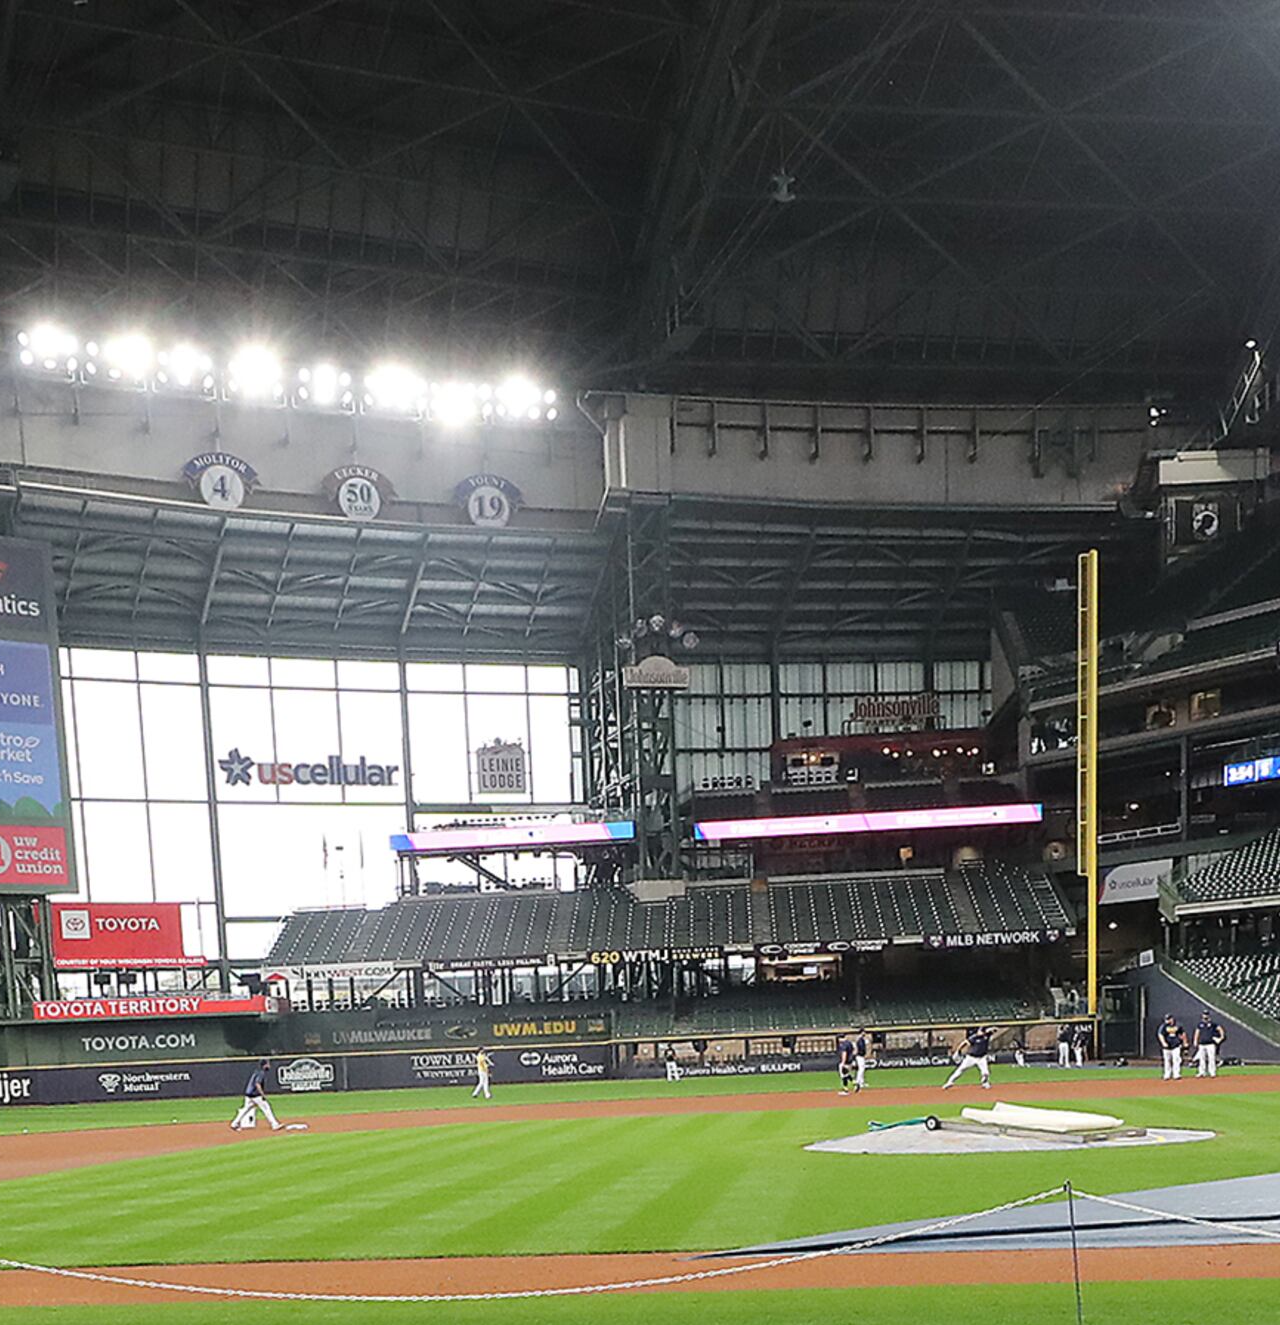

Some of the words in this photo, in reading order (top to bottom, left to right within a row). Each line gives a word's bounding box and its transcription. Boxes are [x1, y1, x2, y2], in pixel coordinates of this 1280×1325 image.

[193, 453, 248, 475] MOLITOR
[333, 466, 380, 482] UECKER
[212, 476, 229, 501] 4
[468, 475, 506, 489] YOUNT
[345, 483, 371, 503] 50
[475, 495, 503, 520] 19
[849, 693, 940, 720] Johnsonville
[256, 760, 399, 786] uscellular
[482, 756, 521, 775] LEINIE
[13, 771, 44, 785] Save
[482, 773, 522, 790] LODGE
[13, 835, 38, 846] uw
[15, 846, 61, 861] credit
[16, 862, 64, 875] union
[95, 918, 160, 931] TOYOTA
[946, 933, 972, 946] MLB
[975, 931, 1041, 945] NETWORK
[591, 951, 620, 964] 620
[622, 950, 670, 963] WTMJ
[38, 1001, 105, 1017] TOYOTA
[108, 998, 200, 1015] TERRITORY
[493, 1020, 577, 1038] UWM.EDU
[82, 1034, 196, 1051] TOYOTA.COM
[410, 1054, 452, 1067] TOWN
[541, 1052, 579, 1063] Aurora
[879, 1058, 904, 1068] Aurora
[905, 1057, 928, 1067] Health
[929, 1057, 950, 1066] Care
[541, 1063, 577, 1075] Health
[579, 1062, 605, 1074] Care
[686, 1065, 711, 1075] Aurora
[711, 1064, 734, 1075] Health
[735, 1065, 757, 1075] Care
[760, 1062, 801, 1072] BULLPEN
[123, 1072, 191, 1083] Northwestern
[123, 1081, 160, 1092] Mutual
